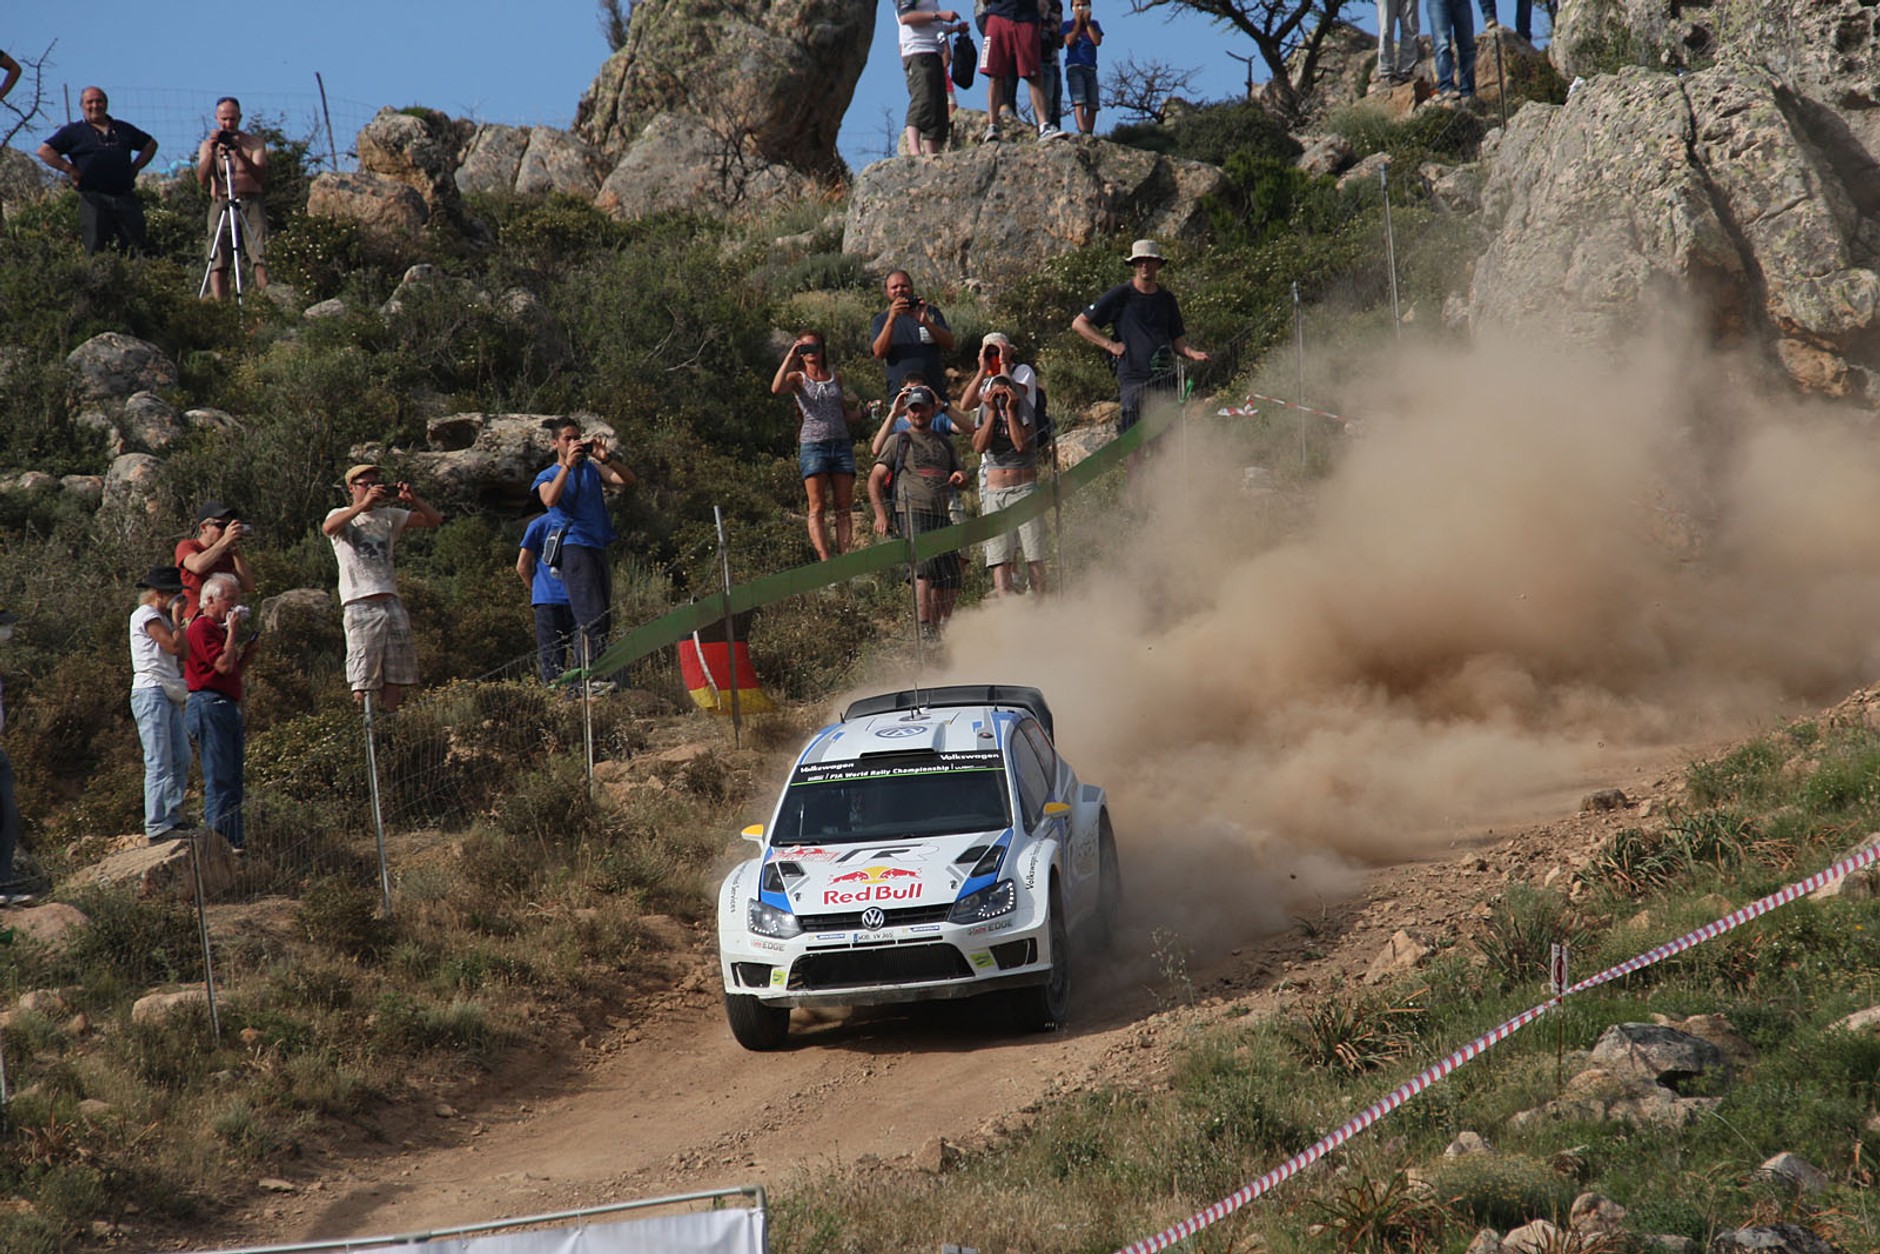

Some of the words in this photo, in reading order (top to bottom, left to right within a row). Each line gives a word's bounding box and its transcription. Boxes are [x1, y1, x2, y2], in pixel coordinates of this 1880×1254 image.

[939, 752, 1000, 761] Volkswagen
[800, 763, 855, 774] Volkswagen
[892, 765, 950, 775] Championship
[823, 886, 872, 905] Red
[875, 883, 924, 901] Bull
